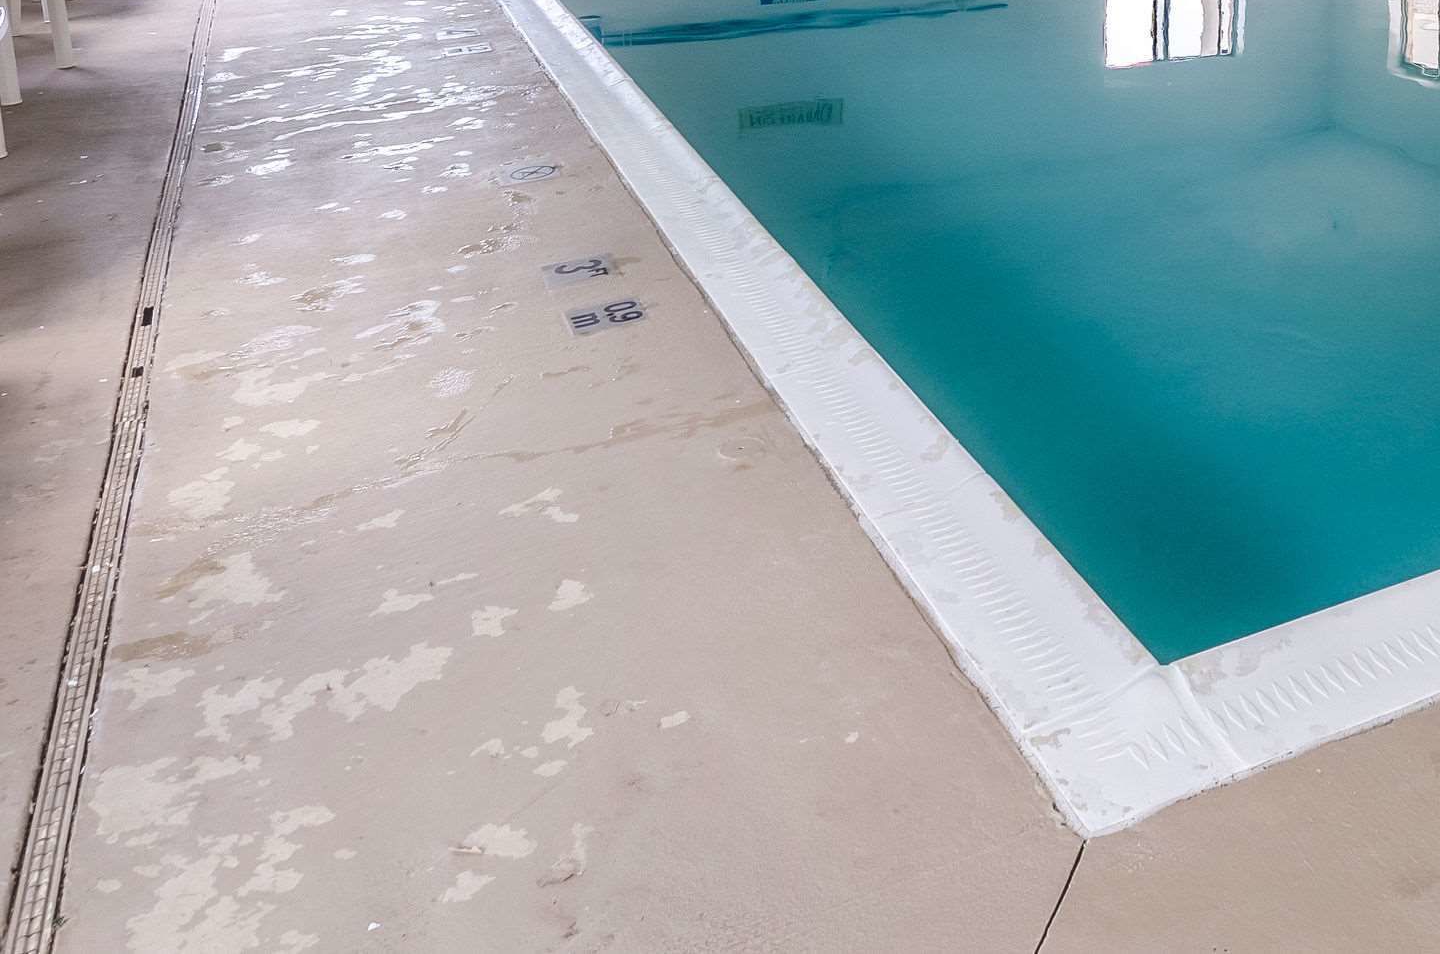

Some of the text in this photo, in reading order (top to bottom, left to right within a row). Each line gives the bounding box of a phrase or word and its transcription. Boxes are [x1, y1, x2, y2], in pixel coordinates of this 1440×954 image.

[554, 258, 609, 278] 3 FT
[570, 311, 601, 329] m
[603, 300, 643, 324] 0.9
